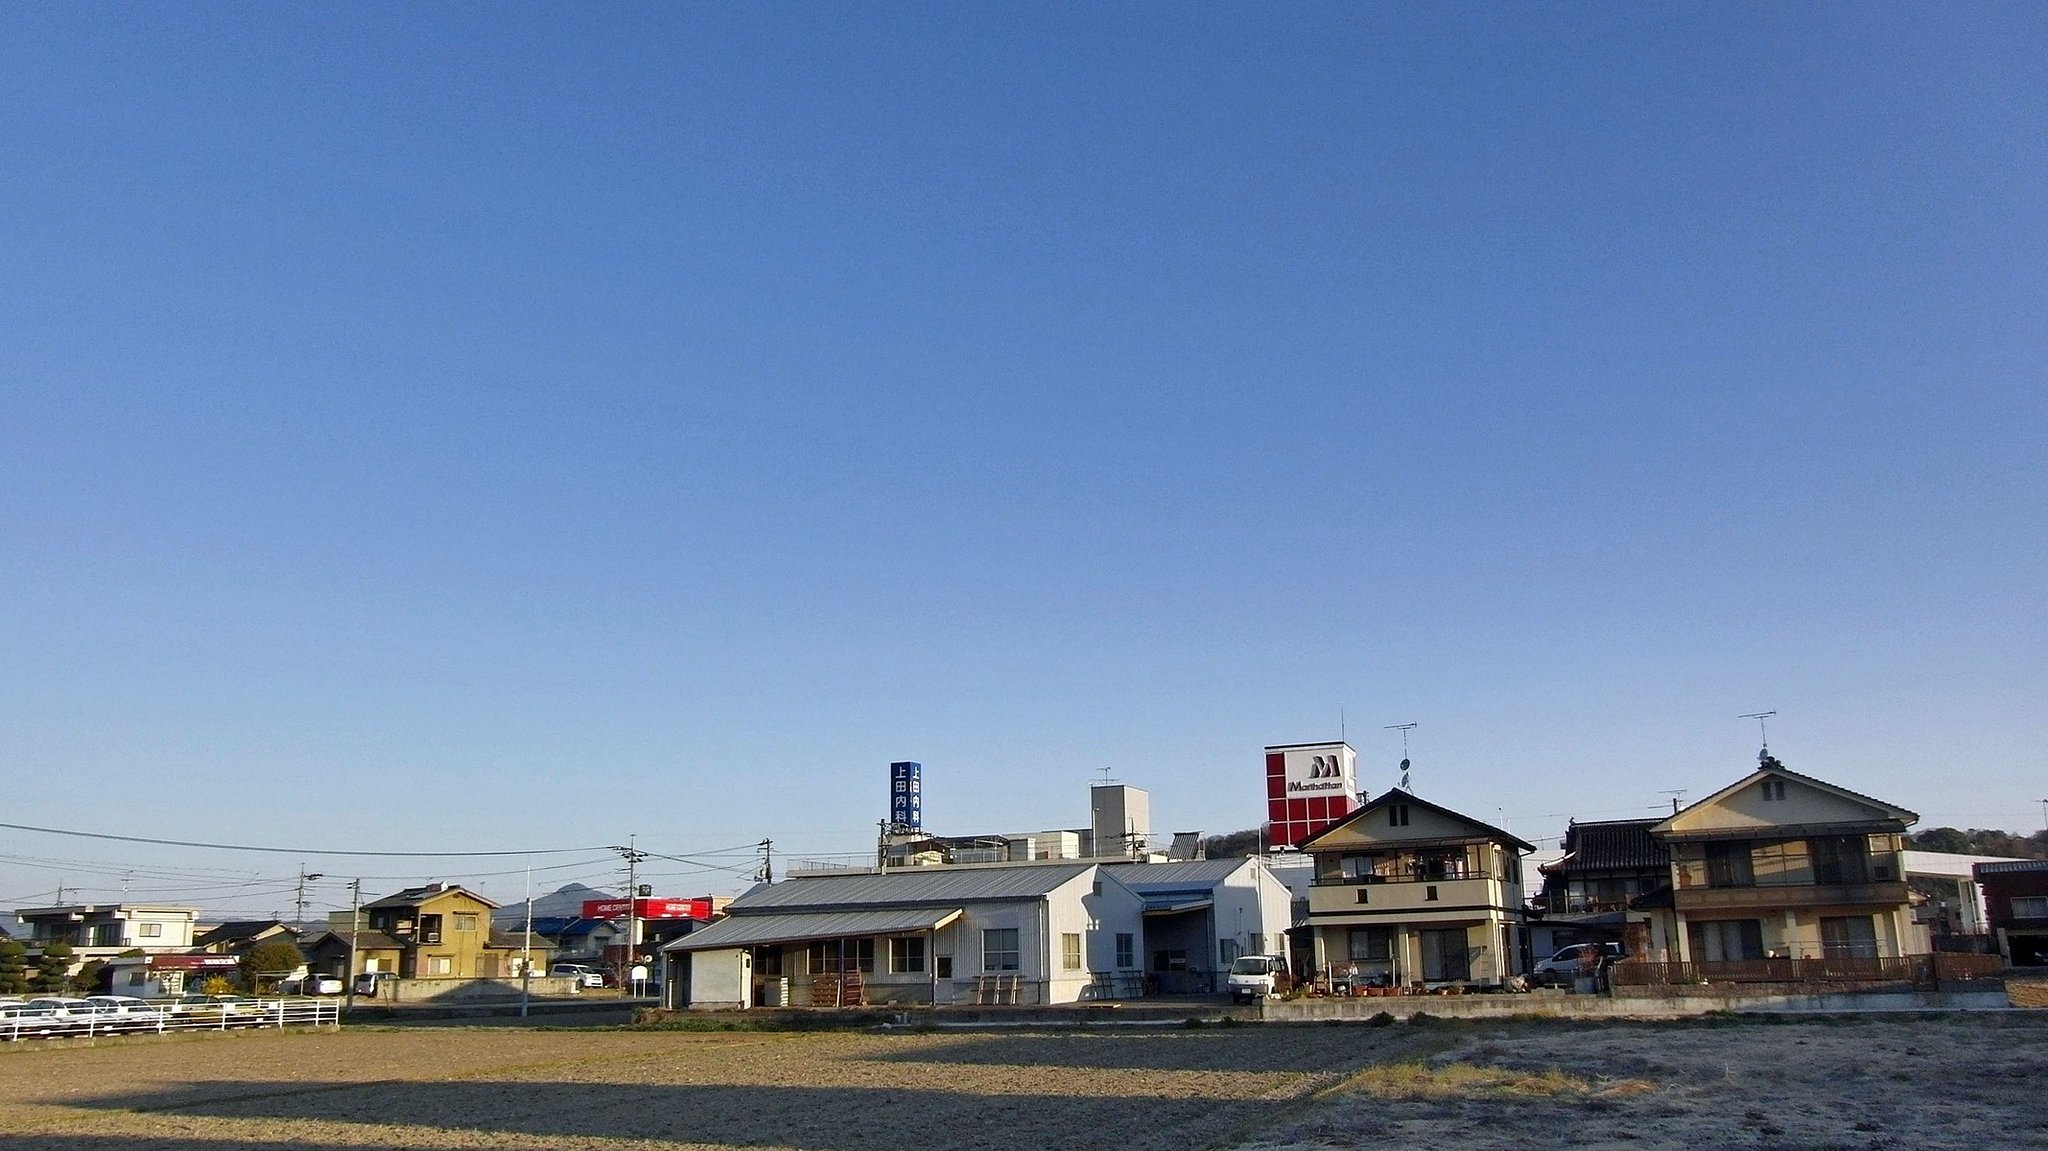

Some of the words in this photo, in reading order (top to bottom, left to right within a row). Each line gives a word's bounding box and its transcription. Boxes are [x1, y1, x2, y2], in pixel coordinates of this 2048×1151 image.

[895, 766, 907, 823] 上田内科
[912, 766, 920, 823] 上田内科
[1288, 781, 1343, 792] Manhattan
[597, 904, 612, 912] HOME
